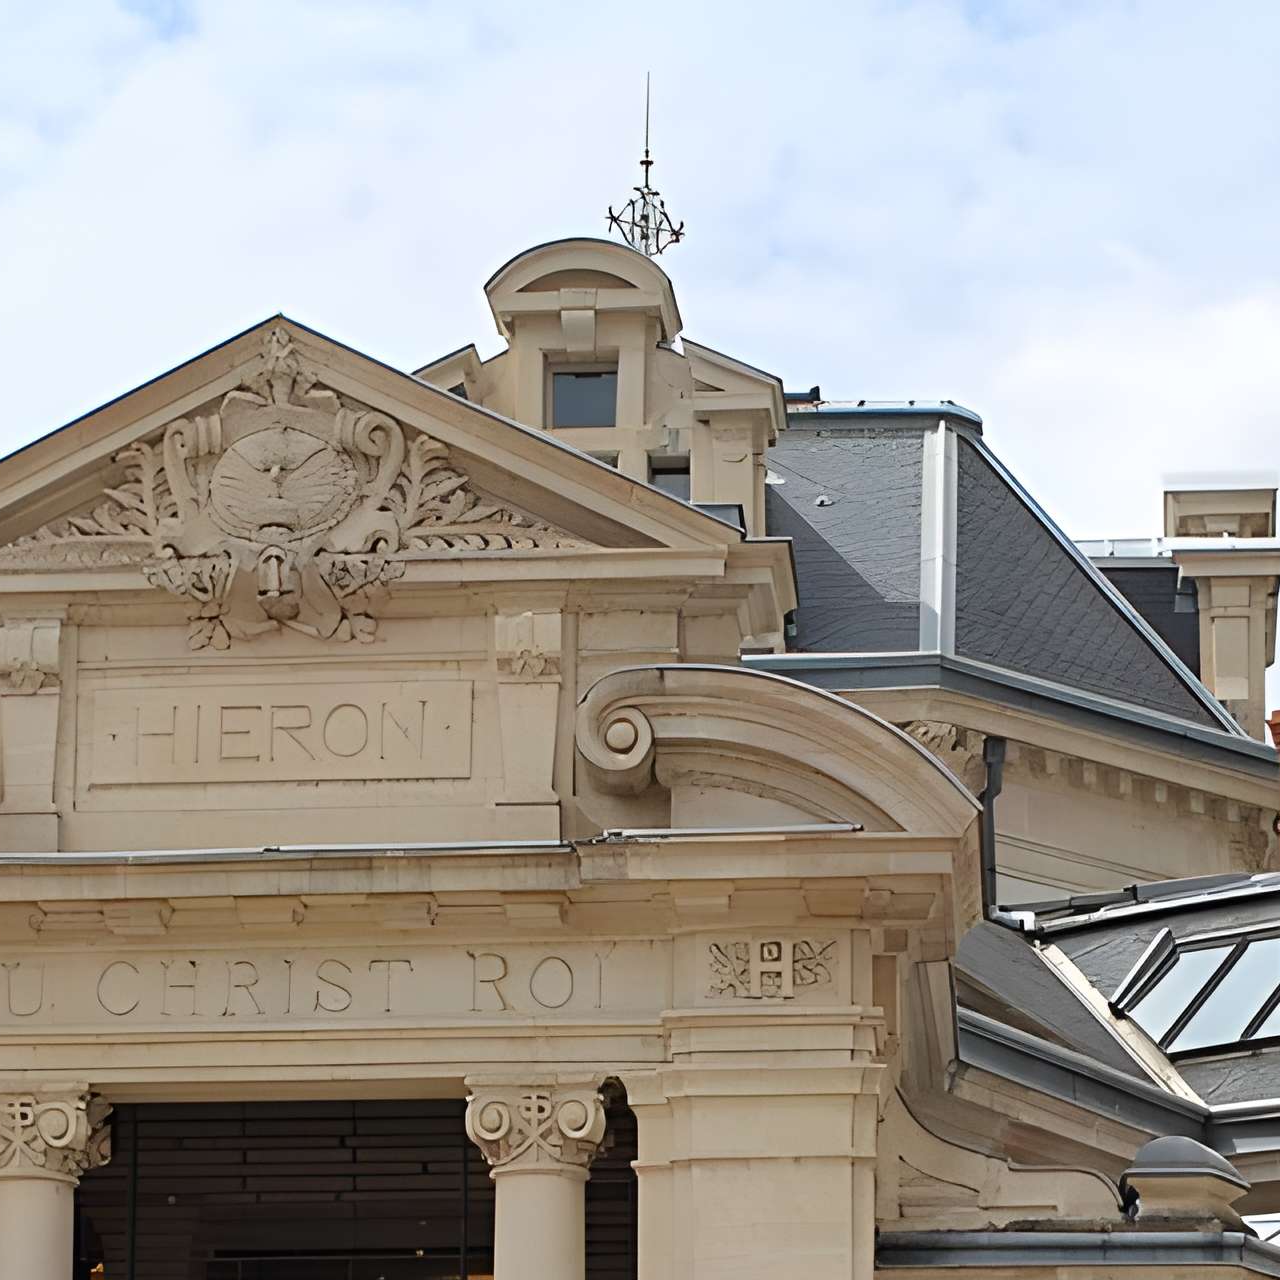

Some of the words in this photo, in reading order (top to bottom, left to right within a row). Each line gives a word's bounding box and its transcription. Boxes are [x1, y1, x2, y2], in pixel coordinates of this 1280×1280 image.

[134, 700, 428, 766] HIERON
[95, 958, 414, 1017] CHRIST
[466, 950, 606, 1013] ROI
